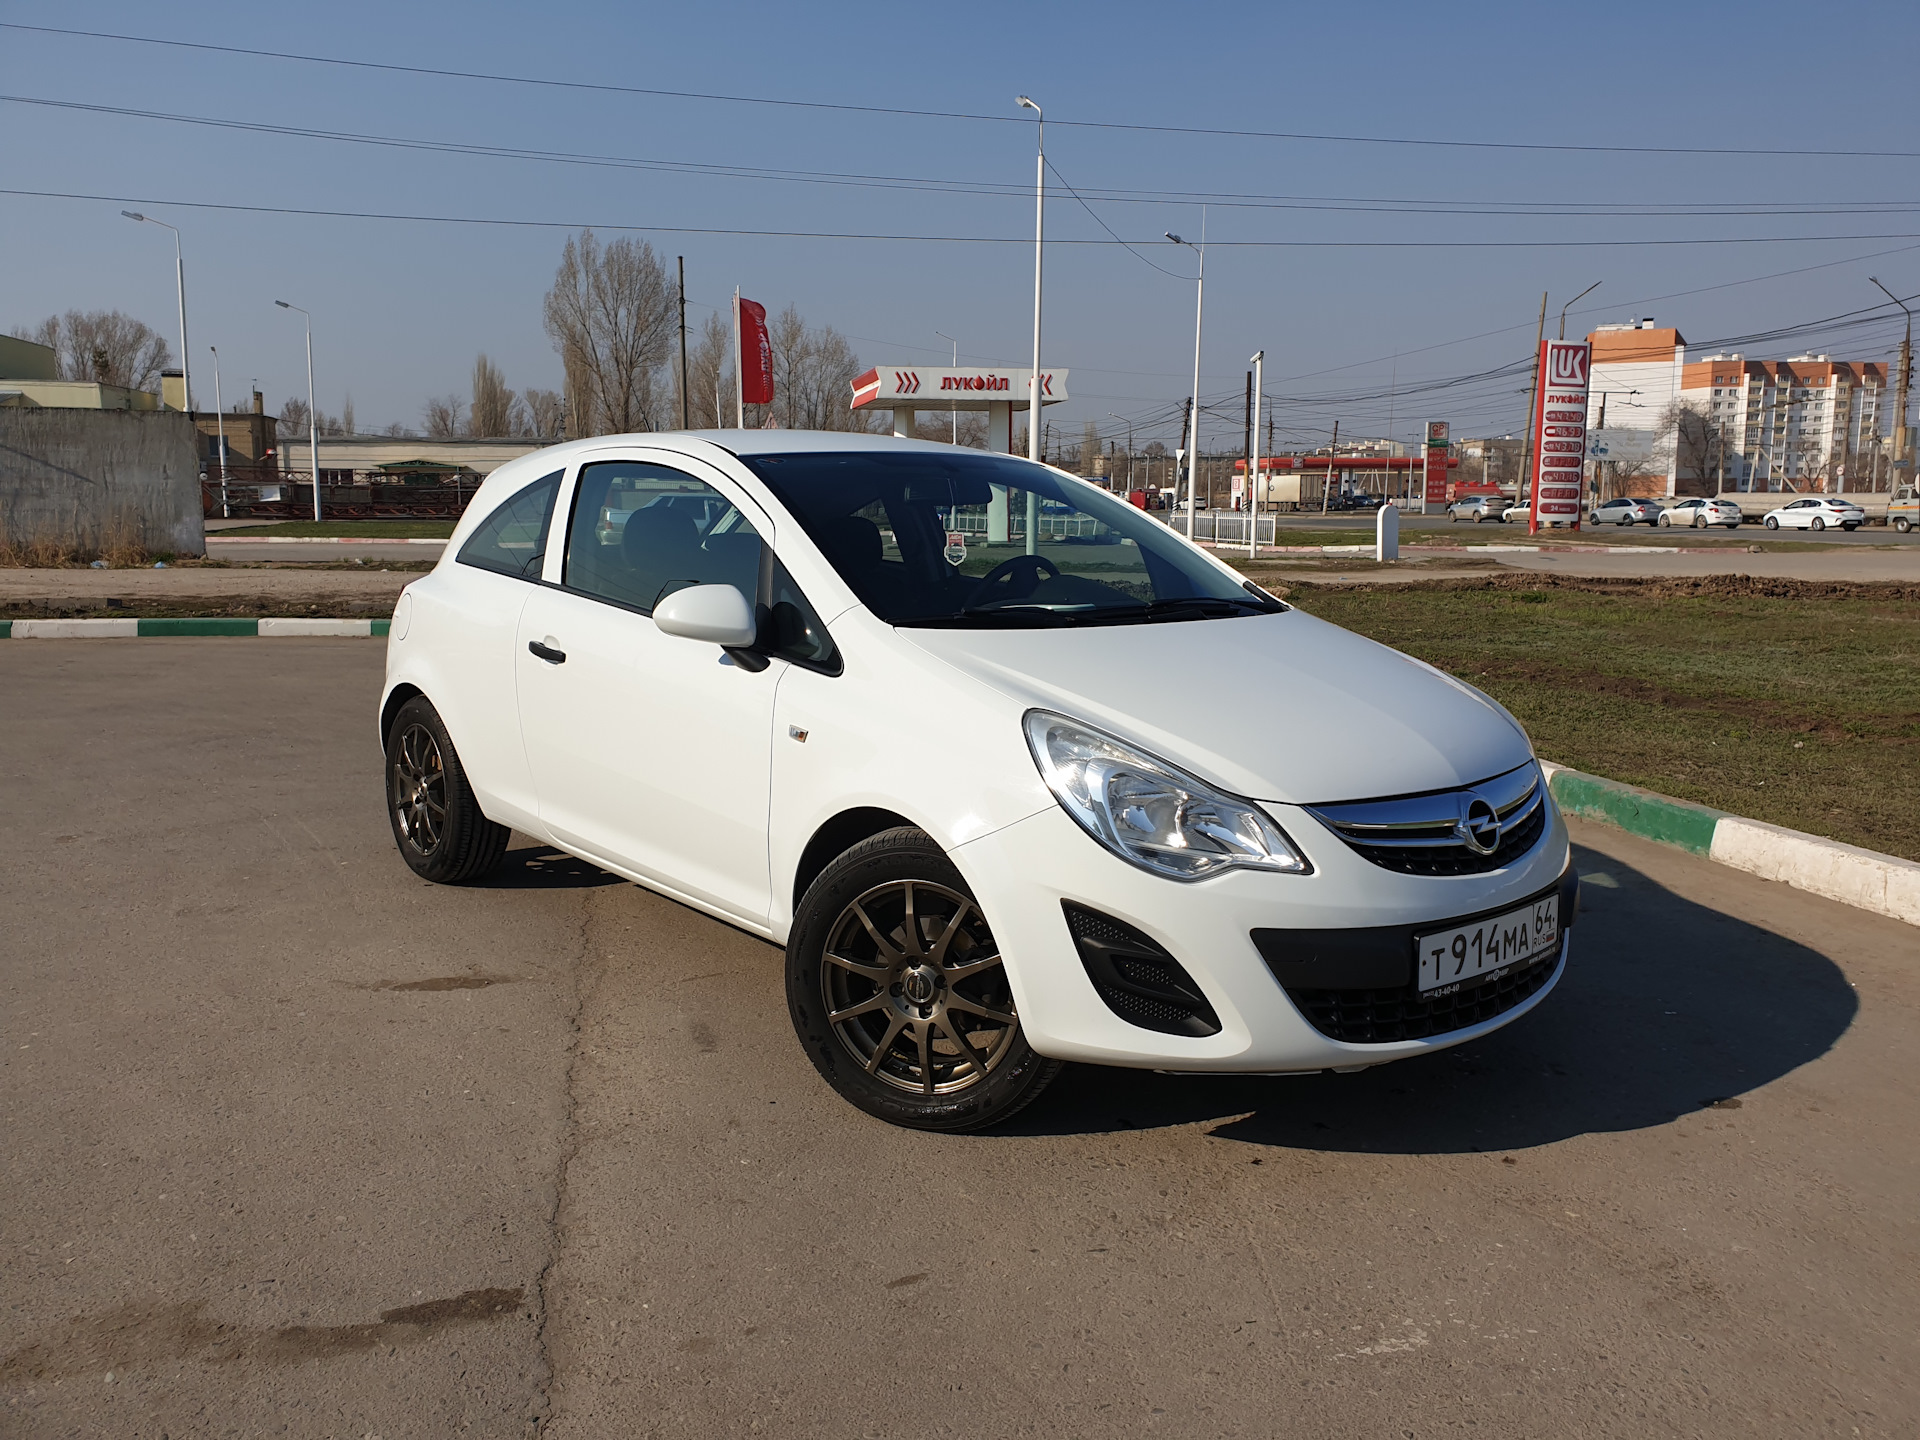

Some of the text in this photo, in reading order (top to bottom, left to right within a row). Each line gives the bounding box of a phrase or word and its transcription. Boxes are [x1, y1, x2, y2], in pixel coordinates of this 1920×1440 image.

[940, 374, 1010, 391] ЛУКОЙЛ
[1547, 393, 1585, 404] ЛУКОЙЛ
[1431, 901, 1552, 981] Т914МА 64
[1533, 933, 1546, 949] RUS
